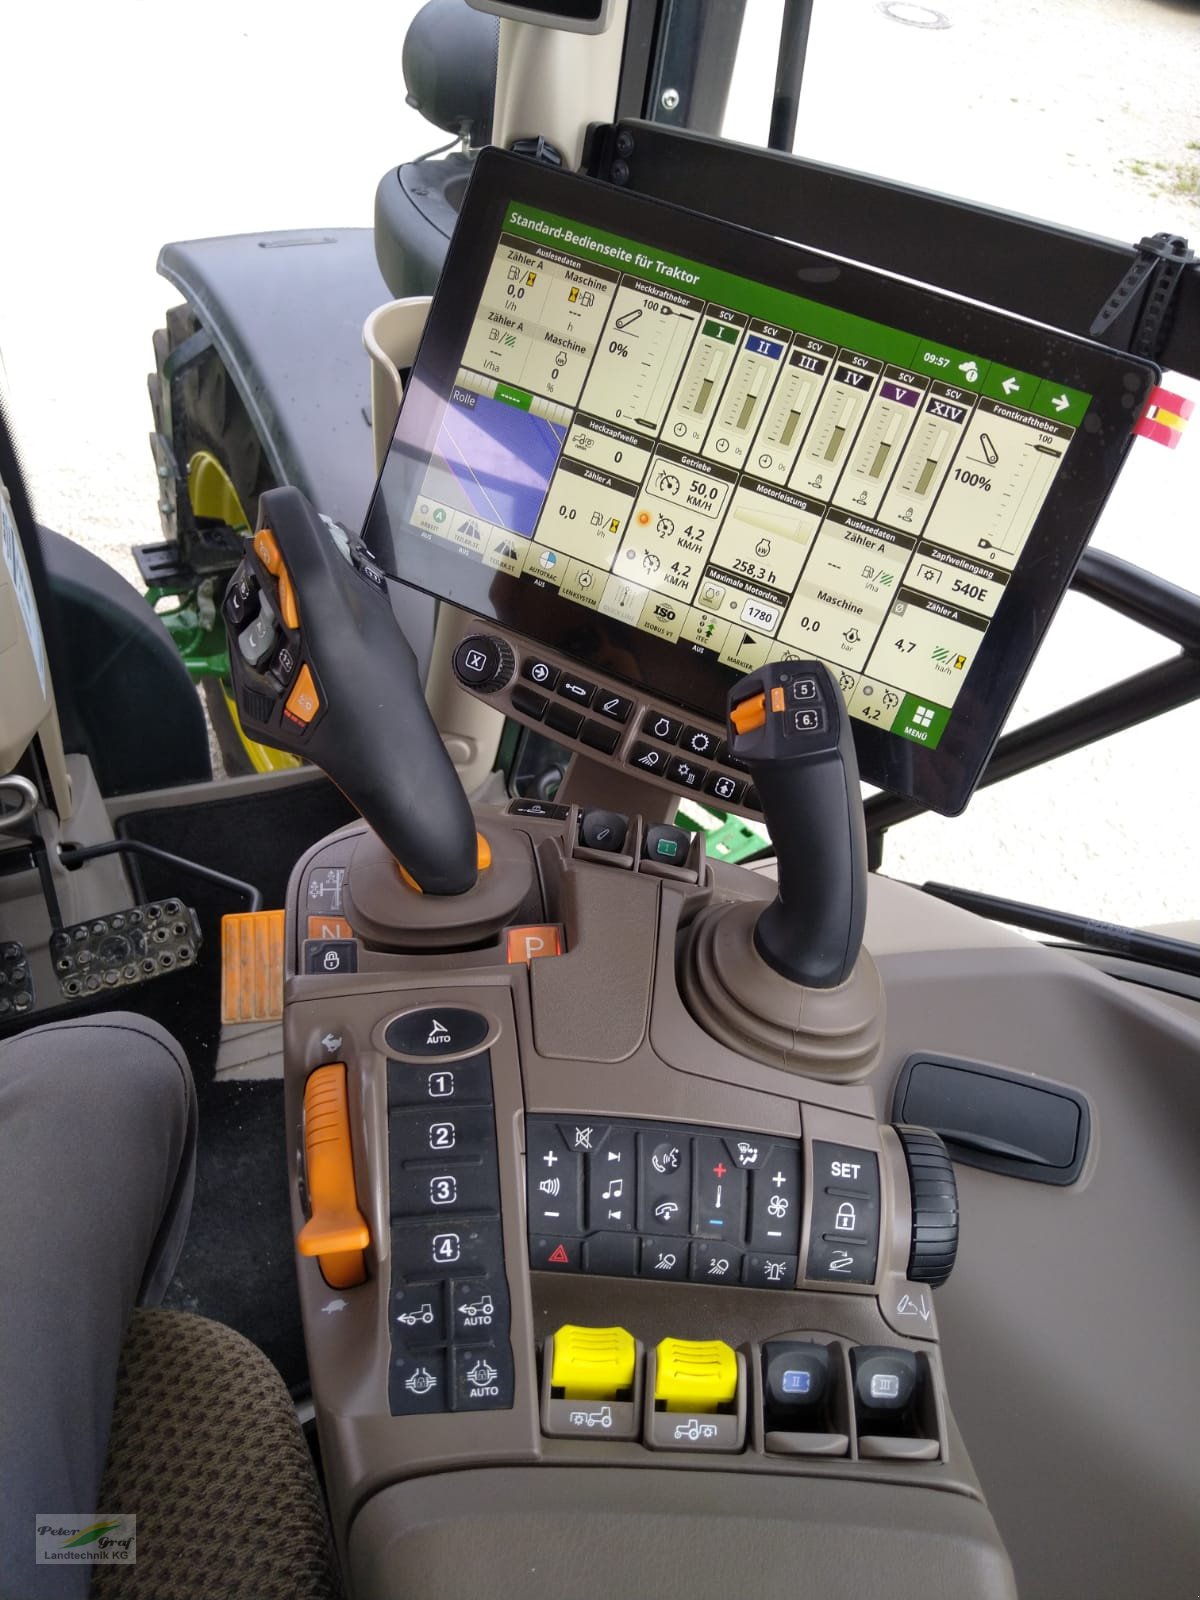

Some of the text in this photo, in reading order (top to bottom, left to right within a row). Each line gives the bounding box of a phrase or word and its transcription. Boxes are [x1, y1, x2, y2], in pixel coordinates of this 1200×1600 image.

[510, 212, 700, 286] Standard-Bedienseite für Traktor
[507, 250, 544, 270] Zähler A
[536, 248, 581, 269] Auslesedaten
[565, 270, 607, 292] Maschine
[507, 284, 524, 299] 0,0
[635, 281, 690, 306] Heckkraftheber
[643, 299, 658, 311] 100
[487, 311, 524, 332] Zähler A
[720, 311, 734, 321] SCV
[567, 322, 573, 332] h
[763, 326, 778, 337] SCV
[544, 332, 586, 354] Maschine
[608, 341, 628, 357] 0%
[758, 341, 771, 354] II
[807, 341, 823, 352] SCV
[799, 355, 817, 371] III
[852, 356, 868, 368] SCV
[923, 352, 950, 368] 09:57
[551, 369, 559, 380] 0
[843, 371, 864, 385] IV
[898, 372, 915, 384] SCV
[546, 384, 554, 393] %
[945, 388, 962, 400] SCV
[453, 390, 476, 407] Rolle
[615, 408, 622, 418] 0
[930, 400, 963, 420] XIV
[993, 405, 1059, 434] Frontkraftheber
[589, 421, 638, 445] Heckzapfwelle
[1038, 434, 1053, 445] 100
[614, 452, 623, 463] 0
[681, 456, 712, 473] Getriebe
[584, 470, 612, 486] Zähler A
[954, 468, 992, 492] 100%
[690, 480, 718, 500] 50,0
[757, 484, 807, 510] Motorleistung
[686, 495, 712, 512] KM/H
[559, 505, 577, 520] 0,0
[684, 525, 705, 542] 4,2
[844, 518, 896, 542] Auslesedaten
[677, 537, 703, 554] KM/H
[844, 531, 886, 553] Zähler A
[670, 561, 692, 578] 4,2
[732, 558, 776, 584] 258,3 h
[931, 549, 994, 580] Zapfwellengang
[529, 566, 557, 581] AUTOTRAC
[663, 573, 689, 590] KM/H
[709, 569, 744, 590] Maximale
[562, 588, 597, 605] LENKSYSTEM
[952, 579, 988, 602] 540E
[817, 590, 864, 615] Maschine
[926, 601, 958, 619] Zähler A
[653, 605, 675, 621] ISO
[749, 606, 773, 623] 1780
[644, 621, 665, 634] ISOBUS
[800, 617, 821, 632] 0,0
[841, 642, 853, 652] bar
[895, 639, 917, 654] 4,7
[801, 685, 808, 695] 5
[862, 706, 881, 721] 4,2
[904, 726, 928, 741] MENÜ
[322, 924, 340, 939] N
[526, 936, 544, 959] P
[426, 1034, 451, 1045] AUTO
[436, 1077, 446, 1092] 1
[436, 1129, 448, 1145] 2
[830, 1161, 861, 1179] SET
[437, 1182, 450, 1199] 3
[439, 1239, 453, 1257] 4
[463, 1315, 492, 1326] AUTO
[470, 1385, 499, 1397] AUTO
